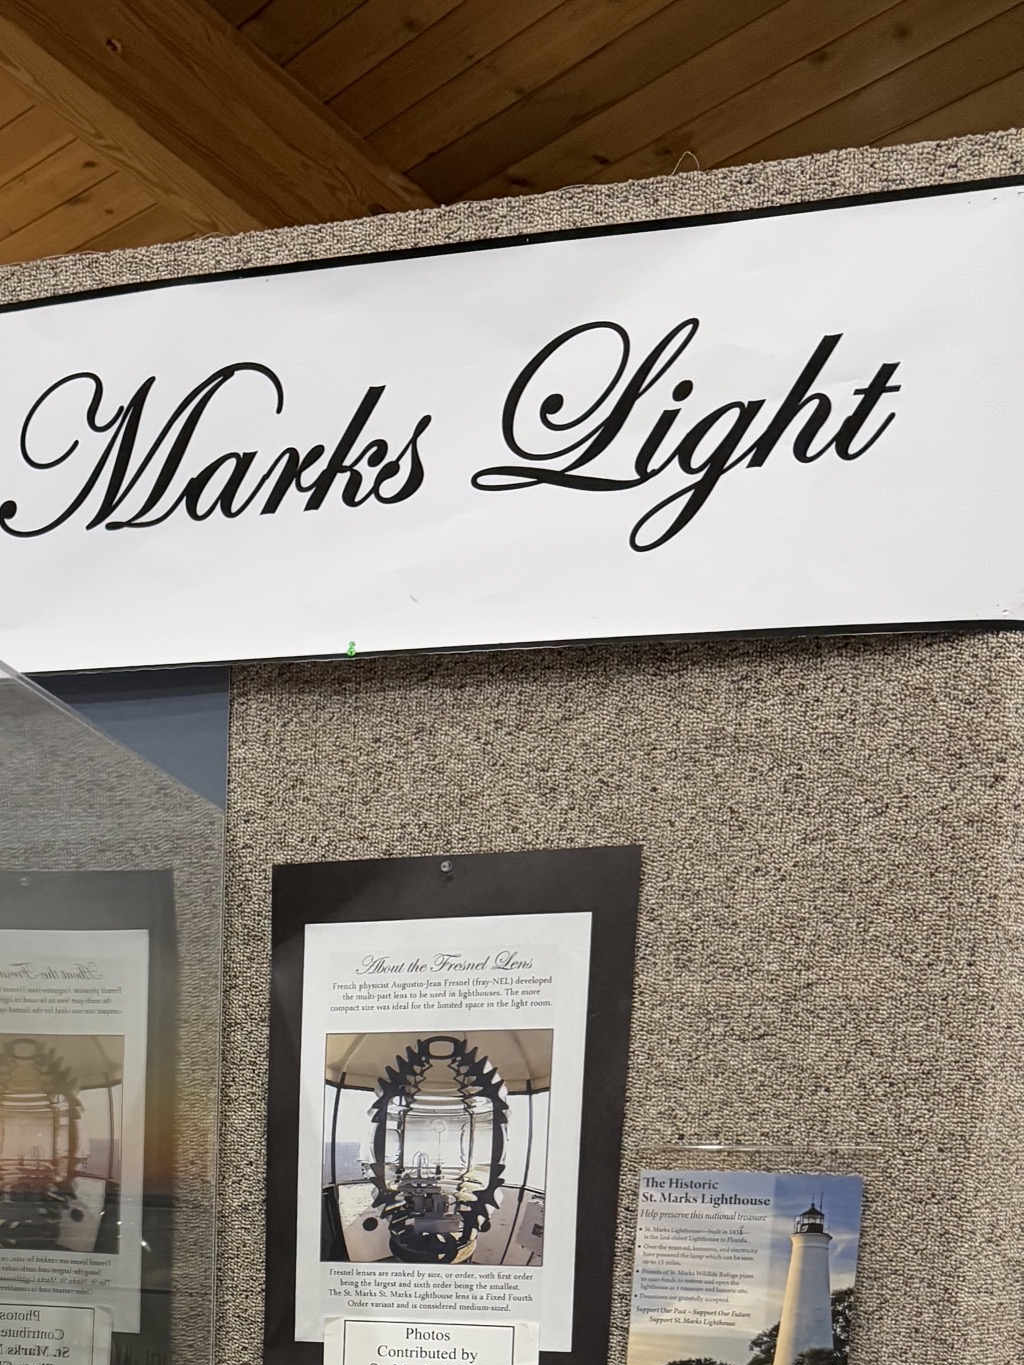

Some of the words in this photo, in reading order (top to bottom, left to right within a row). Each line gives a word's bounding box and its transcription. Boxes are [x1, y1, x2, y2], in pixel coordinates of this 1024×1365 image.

[0, 361, 432, 538] Marks
[472, 318, 902, 552] Light
[356, 955, 404, 974] About
[407, 958, 427, 973] the
[430, 953, 490, 972] Fresnel
[491, 950, 533, 970] Lens
[333, 982, 356, 990] French
[359, 981, 389, 991] physicist
[391, 980, 441, 990] Augustin-Jean
[444, 978, 469, 986] Fresnel
[472, 977, 513, 987] (fray-NEL)
[515, 976, 552, 986] developed
[356, 992, 391, 1001] multi-part
[394, 991, 407, 999] lens
[419, 990, 427, 998] be
[430, 990, 446, 998] used
[459, 989, 502, 999] lighthouses.
[505, 988, 518, 996] The
[331, 1005, 359, 1013] compact
[392, 1002, 408, 1010] ideal
[411, 1001, 421, 1010] for
[437, 1000, 462, 1009] limited
[465, 1001, 484, 1010] space
[511, 999, 527, 1009] light
[643, 1177, 665, 1188] The
[669, 1178, 718, 1190] Historic
[642, 1192, 656, 1203] St.
[660, 1193, 697, 1204] Marks
[701, 1194, 770, 1208] Lighthouse
[640, 1209, 656, 1219] Help
[659, 1211, 689, 1220] preserve
[690, 1211, 703, 1219] this
[705, 1212, 735, 1220] national
[737, 1213, 767, 1221] treasure
[417, 1270, 426, 1280] by
[340, 1279, 358, 1288] being
[361, 1279, 371, 1287] the
[374, 1279, 396, 1289] largest
[454, 1282, 473, 1291] being
[414, 1291, 453, 1301] Lighthouse
[419, 1302, 456, 1310] considered
[459, 1303, 511, 1312] medium-sized.
[406, 1328, 450, 1341] Photos
[377, 1345, 456, 1360] Contributed
[462, 1348, 478, 1363] by
